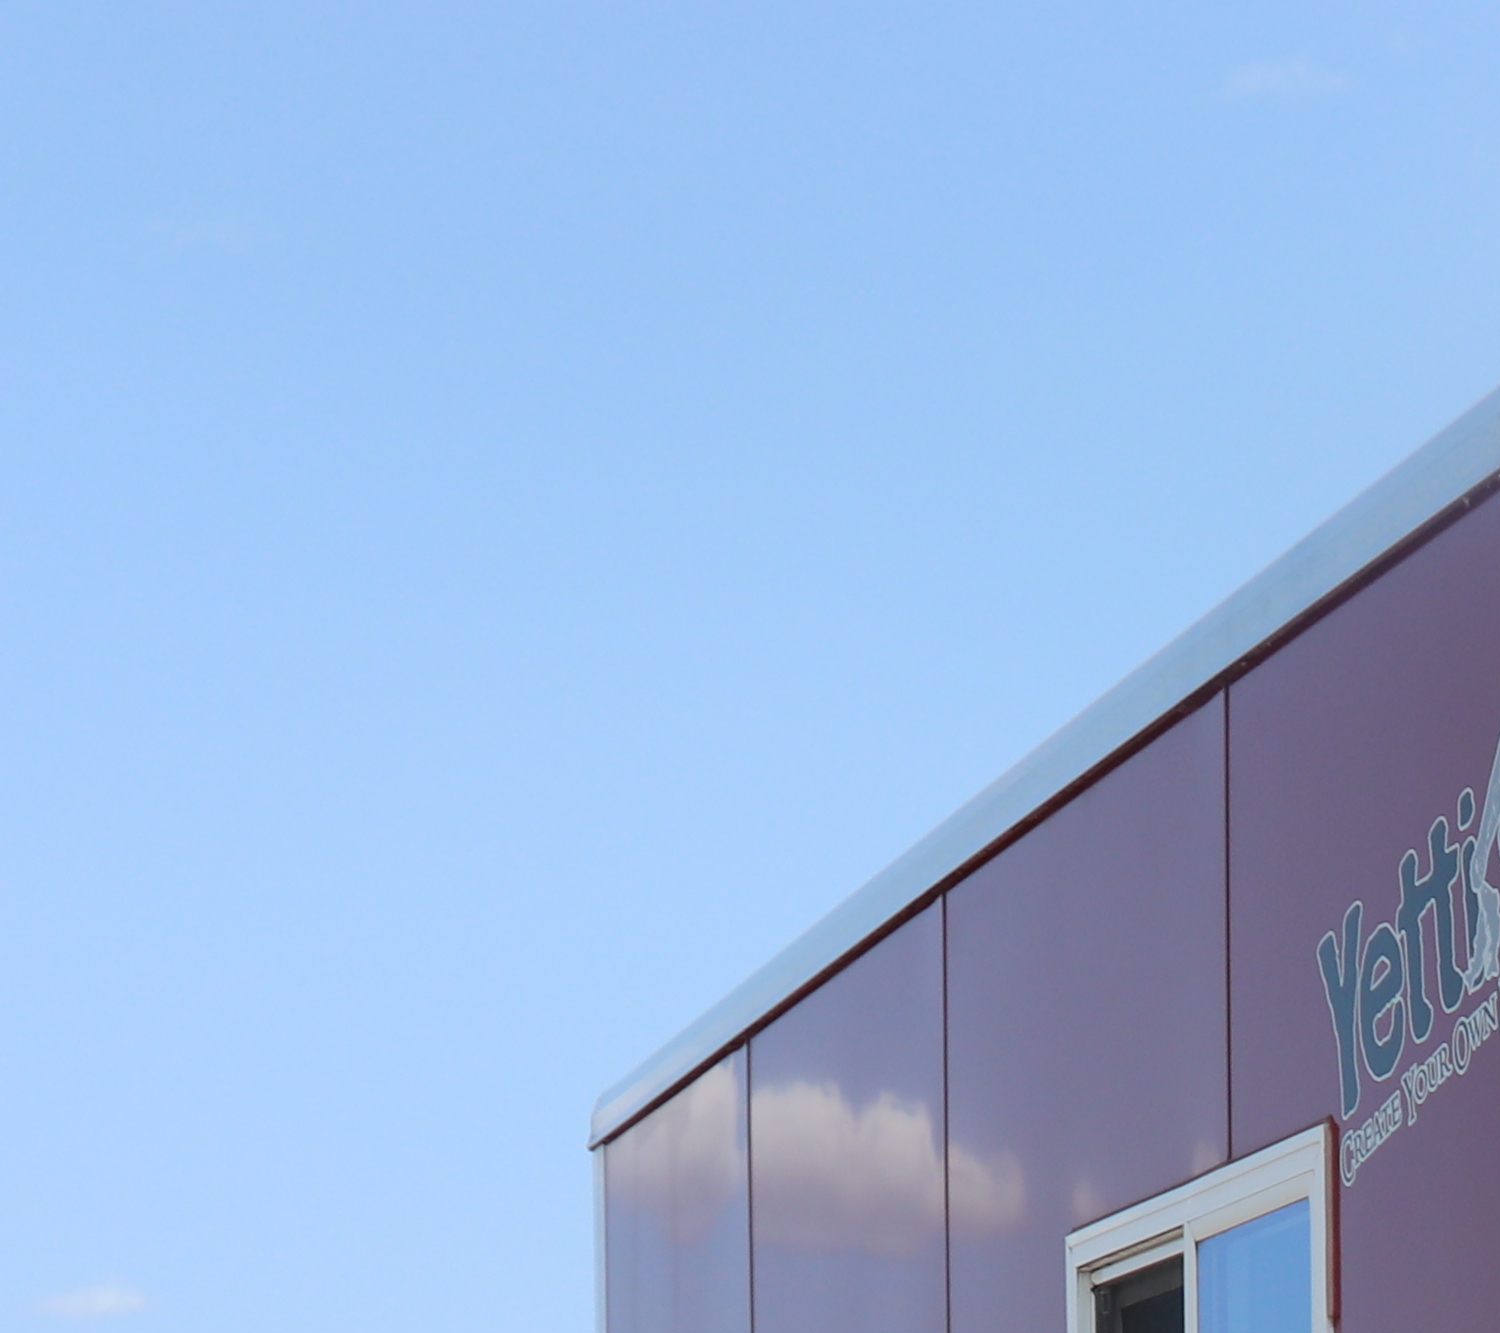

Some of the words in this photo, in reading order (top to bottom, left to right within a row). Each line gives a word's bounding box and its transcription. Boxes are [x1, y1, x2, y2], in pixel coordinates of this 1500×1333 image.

[1317, 787, 1492, 1120] Yetti
[1339, 1089, 1402, 1187] CREATE
[1401, 1042, 1452, 1126] YOUR
[1452, 989, 1499, 1075] OWN
